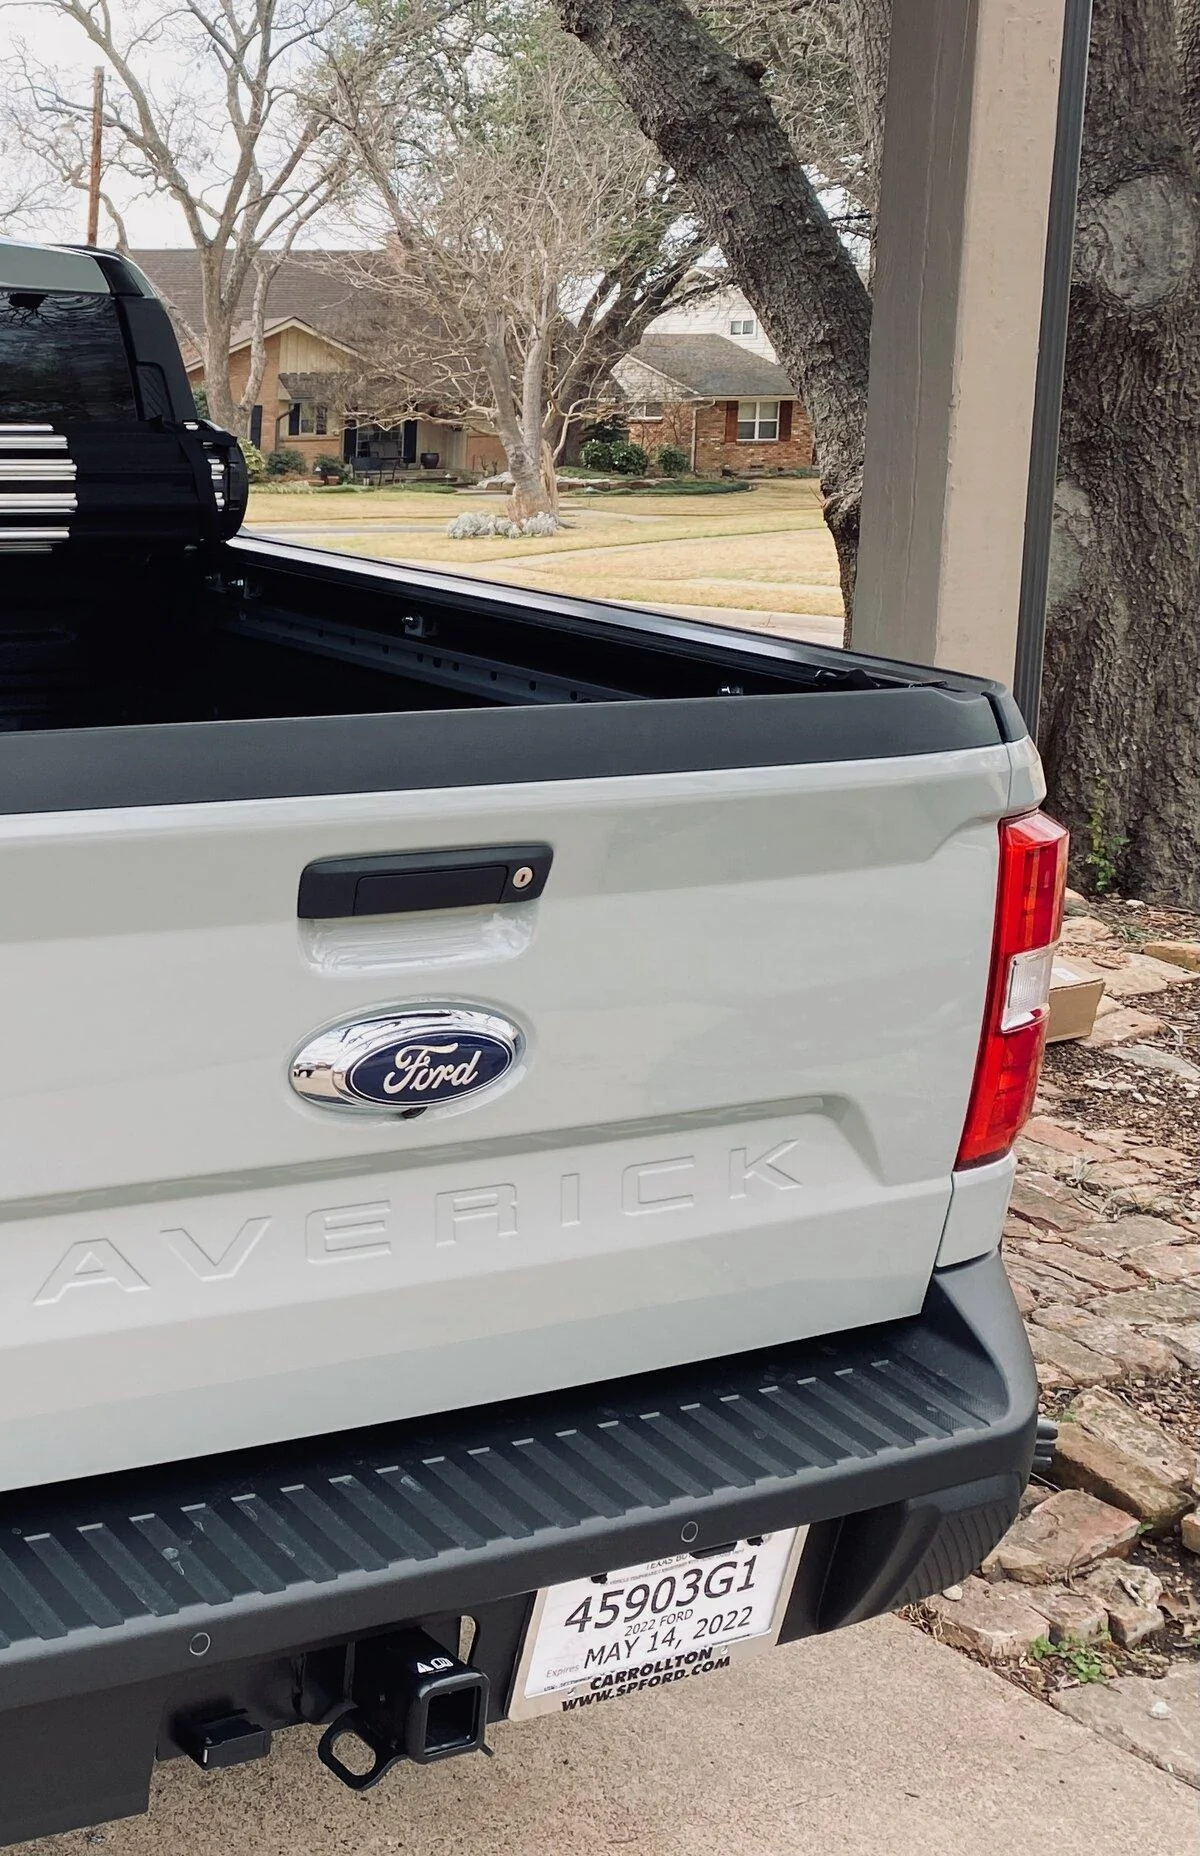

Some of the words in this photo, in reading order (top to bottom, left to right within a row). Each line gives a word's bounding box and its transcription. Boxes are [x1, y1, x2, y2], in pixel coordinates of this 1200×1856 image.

[383, 1042, 482, 1094] Ford
[564, 1554, 757, 1633] 45903G1
[546, 1664, 580, 1678] Expires
[584, 1637, 640, 1669] MAY
[646, 1626, 682, 1653] 14,
[692, 1606, 753, 1640] 2022
[624, 1618, 655, 1637] 2022
[659, 1608, 694, 1627] FORD
[561, 1655, 731, 1712] WWW.SPFORD.COM
[590, 1647, 714, 1691] CARROLLTON
